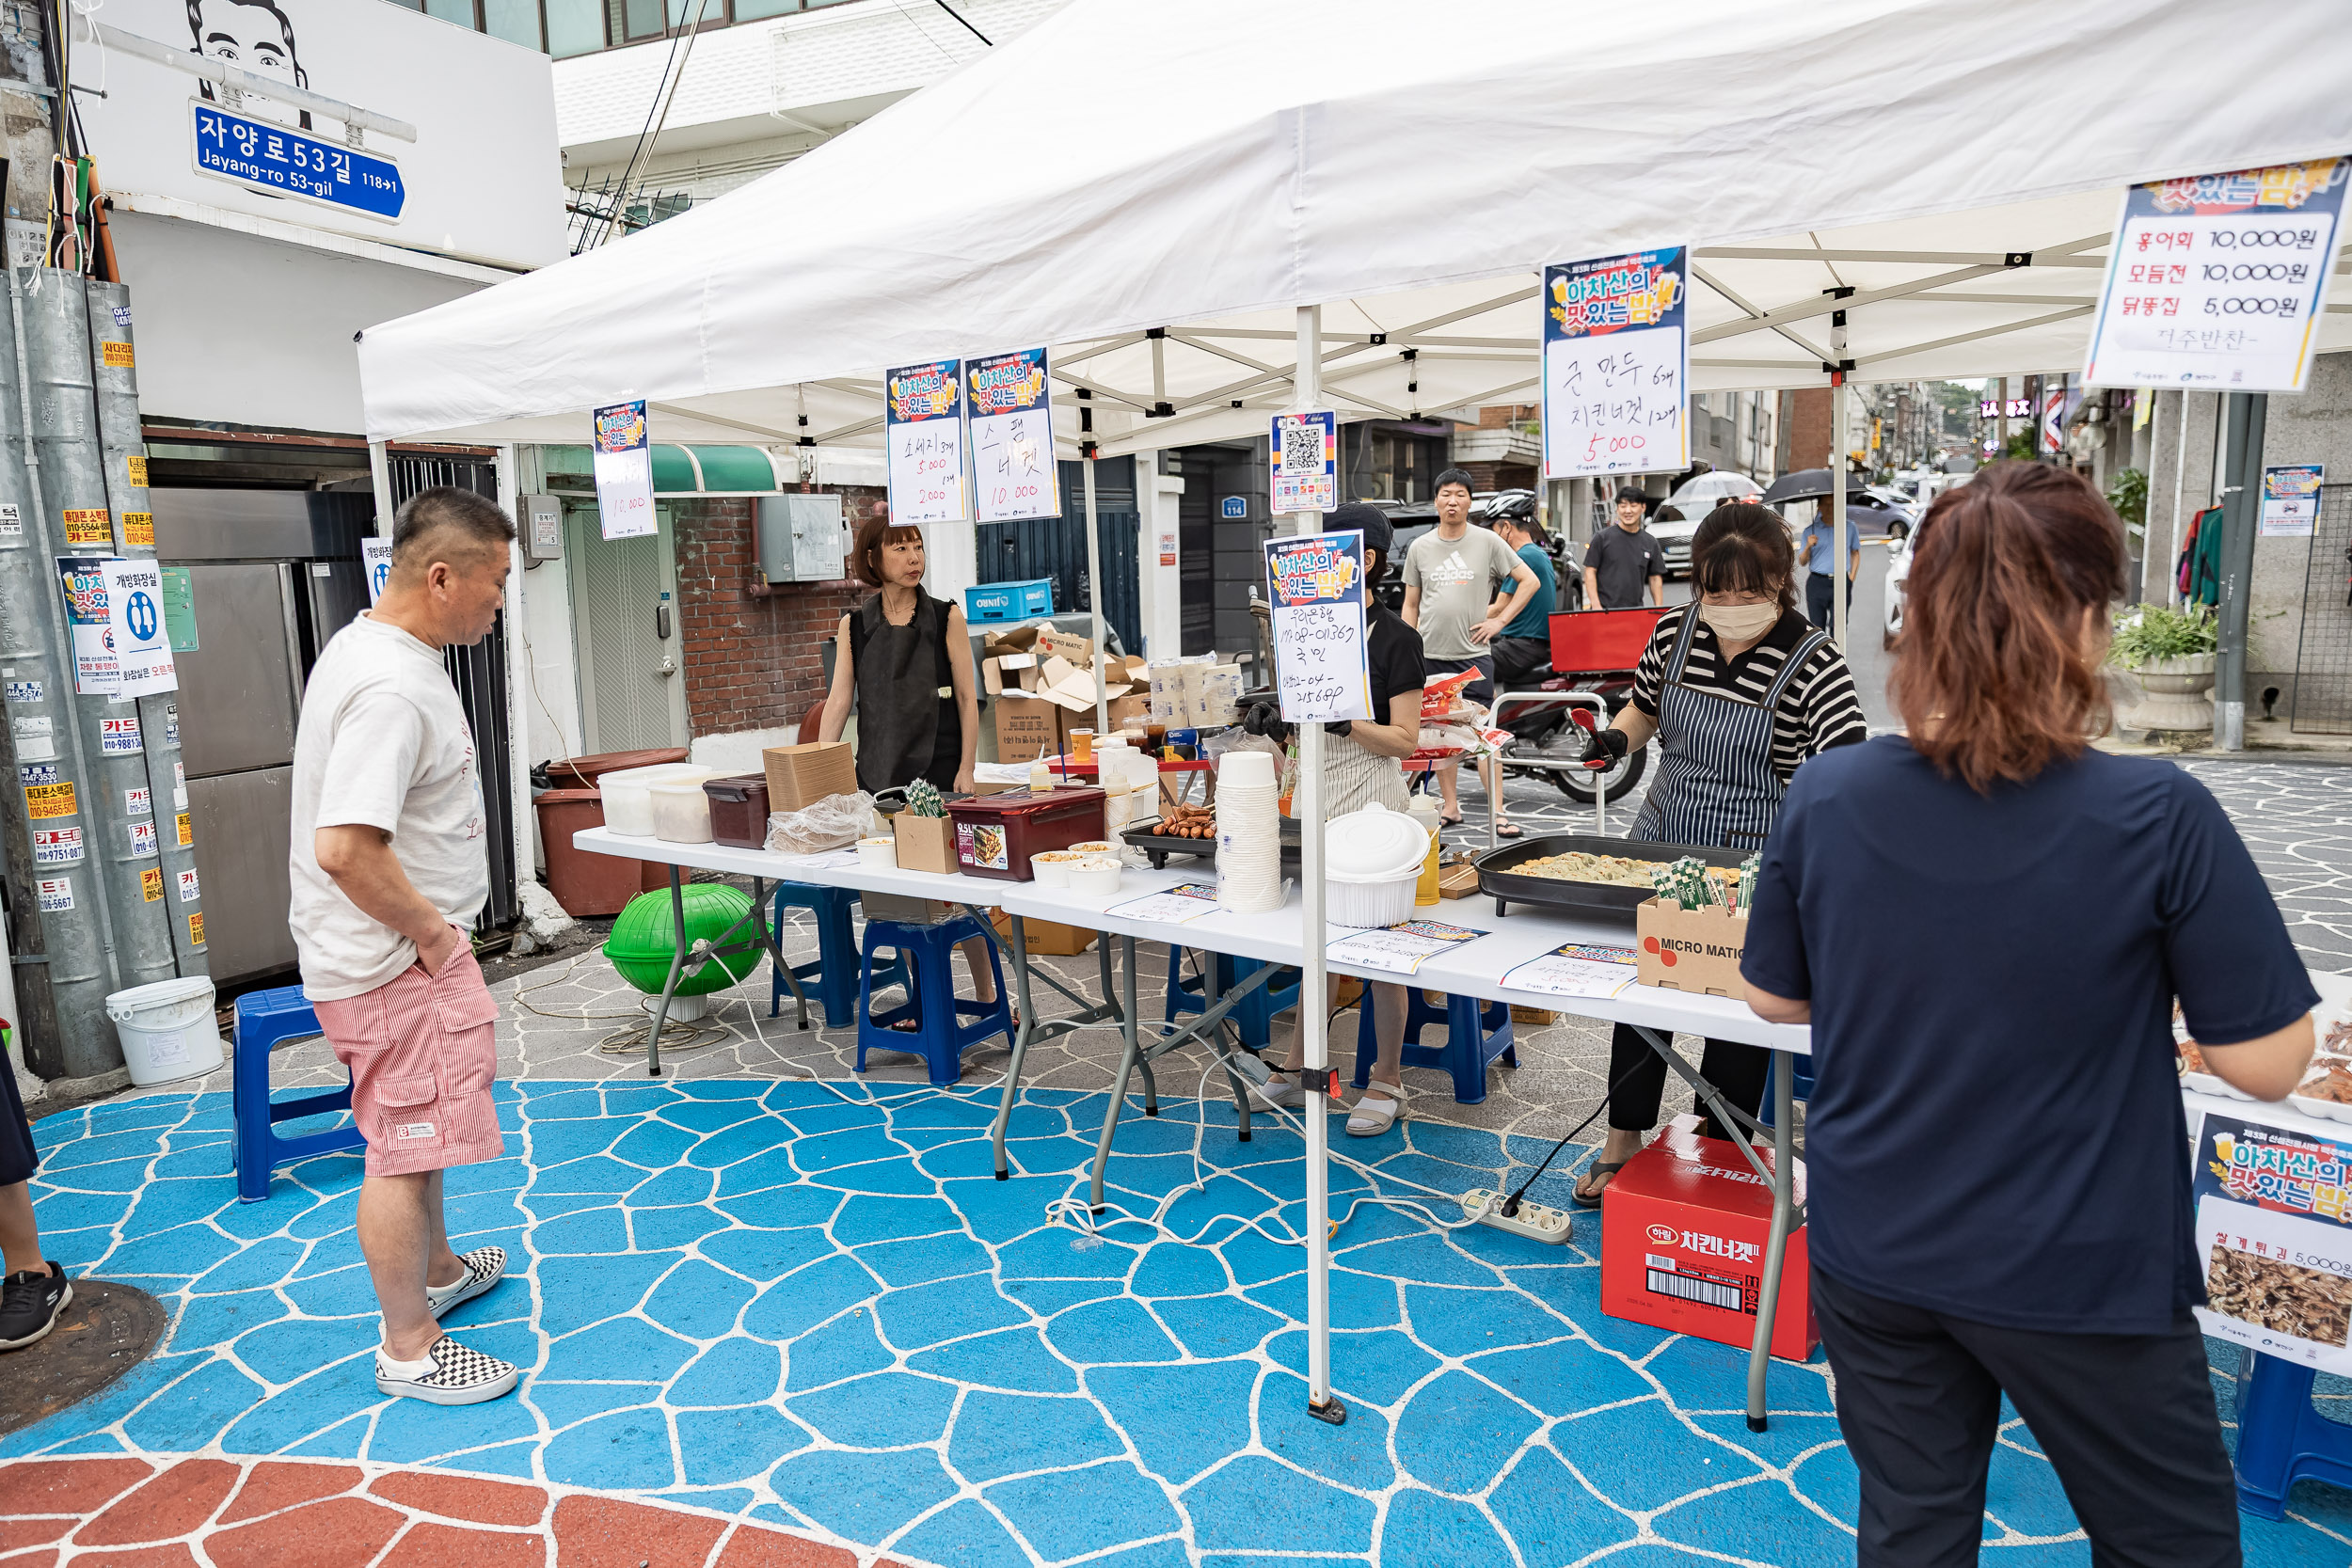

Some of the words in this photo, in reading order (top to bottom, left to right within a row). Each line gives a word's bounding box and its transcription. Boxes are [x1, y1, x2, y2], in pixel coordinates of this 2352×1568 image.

[203, 148, 284, 183] Jayang-ro
[290, 172, 332, 197] 53-gil
[2136, 231, 2194, 252] 홍어회
[2208, 229, 2317, 251] 10,000원
[2127, 263, 2186, 283] 모듬전
[2201, 263, 2309, 284] 10,000원
[1567, 269, 1648, 303] 아차산의
[2122, 297, 2181, 317] 닭똥집
[2203, 296, 2299, 318] 5,000원
[898, 374, 942, 397] 아차산의
[979, 364, 1027, 388] 아차산의
[602, 412, 634, 433] 아차산의
[1227, 506, 1242, 515] 114
[367, 546, 392, 558] 개방화장
[1278, 552, 1332, 577] 아차산의
[117, 572, 158, 589] 개방화장실
[976, 596, 1000, 608] JINRO
[1047, 638, 1064, 646] MICRO
[123, 668, 151, 681] 화장실은
[103, 720, 136, 732] 카드
[1661, 938, 1703, 954] MICRO
[2233, 1145, 2344, 1187] 아차산의
[1652, 1227, 1672, 1241] 하림
